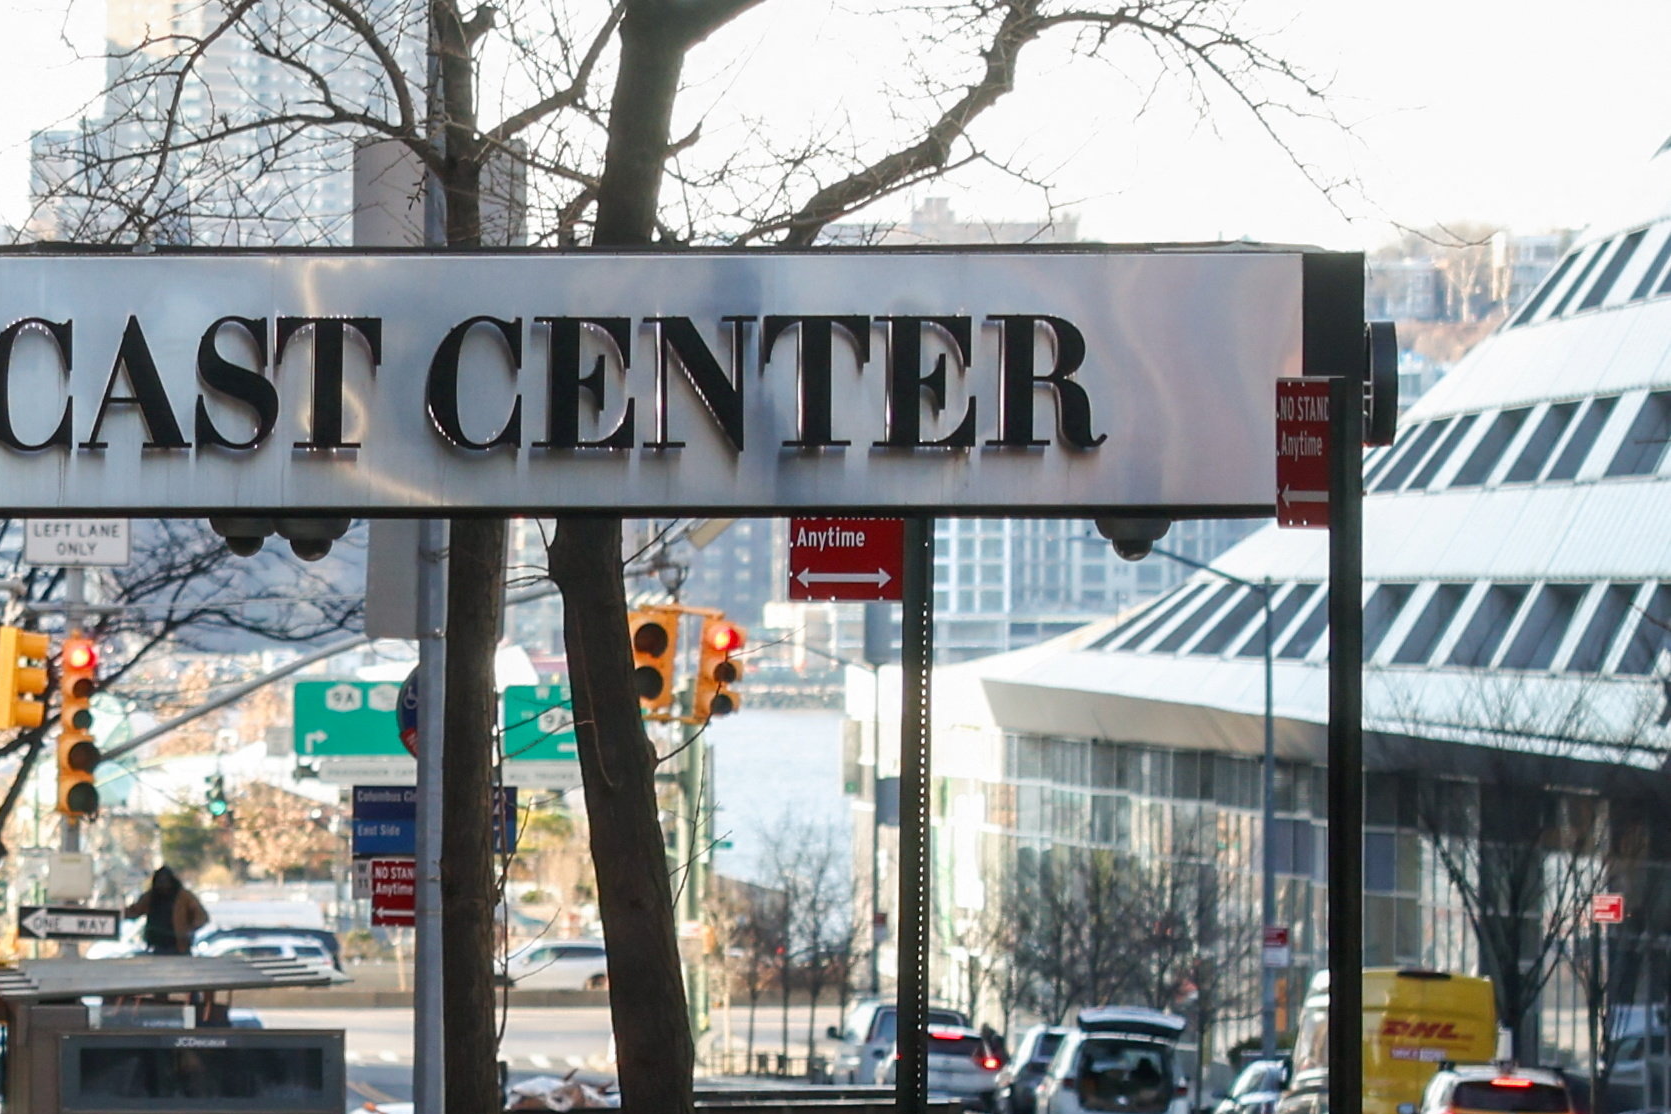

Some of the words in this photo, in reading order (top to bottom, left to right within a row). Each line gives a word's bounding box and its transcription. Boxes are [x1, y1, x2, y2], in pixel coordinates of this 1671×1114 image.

[426, 313, 1107, 453] CENTER
[1280, 396, 1294, 421] NO
[1281, 430, 1322, 462] Anytime
[34, 524, 70, 537] LEFT
[78, 524, 120, 537] LANE
[796, 526, 866, 552] Anytime
[56, 542, 97, 556] ONLY
[357, 790, 401, 802] Columbus
[357, 823, 378, 837] East
[379, 823, 401, 837] Side
[375, 866, 389, 880] NO
[376, 881, 414, 897] Anytime
[33, 916, 59, 930] ONE
[77, 918, 108, 930] WAY
[1382, 1019, 1460, 1041] DHL
